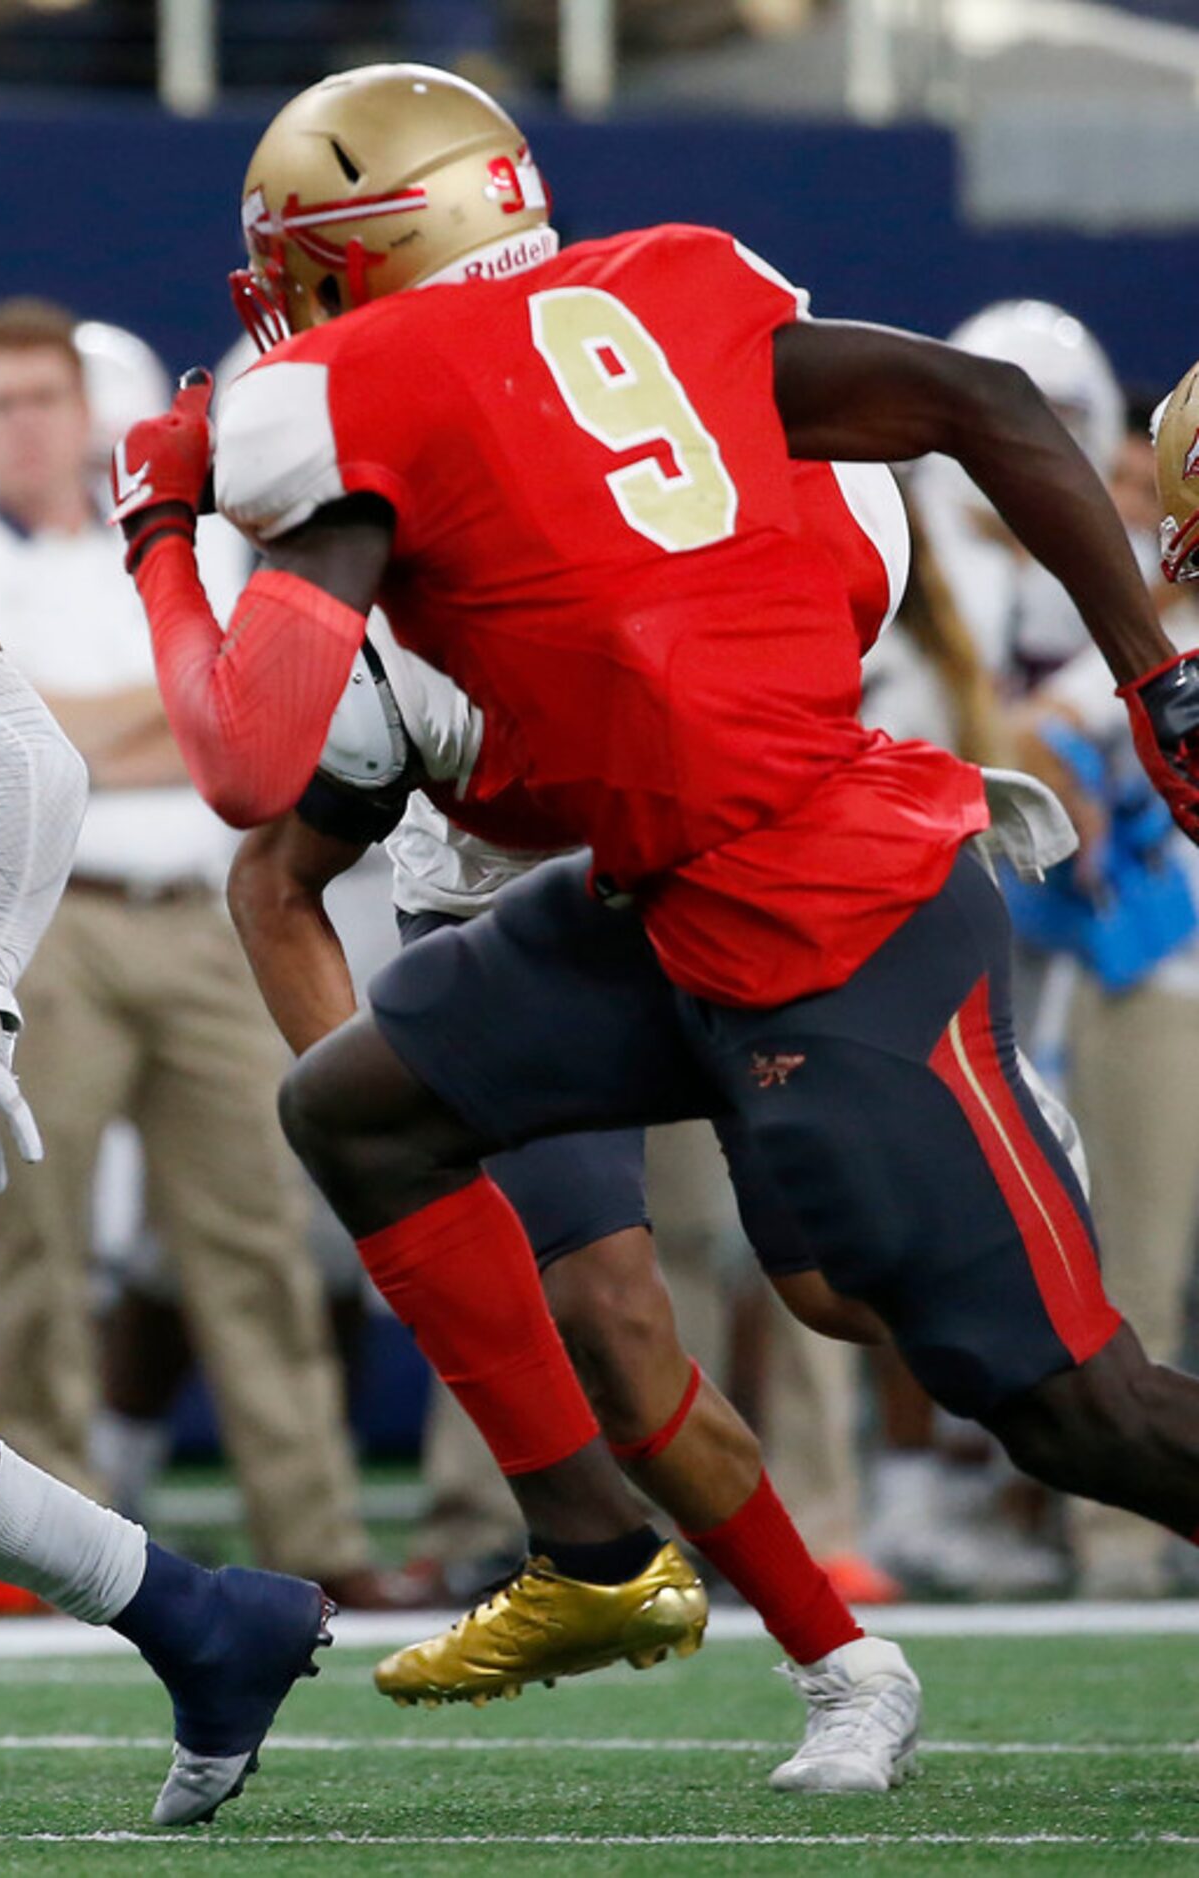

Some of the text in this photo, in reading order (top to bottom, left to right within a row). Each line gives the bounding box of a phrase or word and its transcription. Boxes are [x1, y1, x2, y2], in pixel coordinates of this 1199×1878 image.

[486, 156, 525, 214] 9
[465, 235, 555, 281] Riddell
[528, 286, 738, 553] 9
